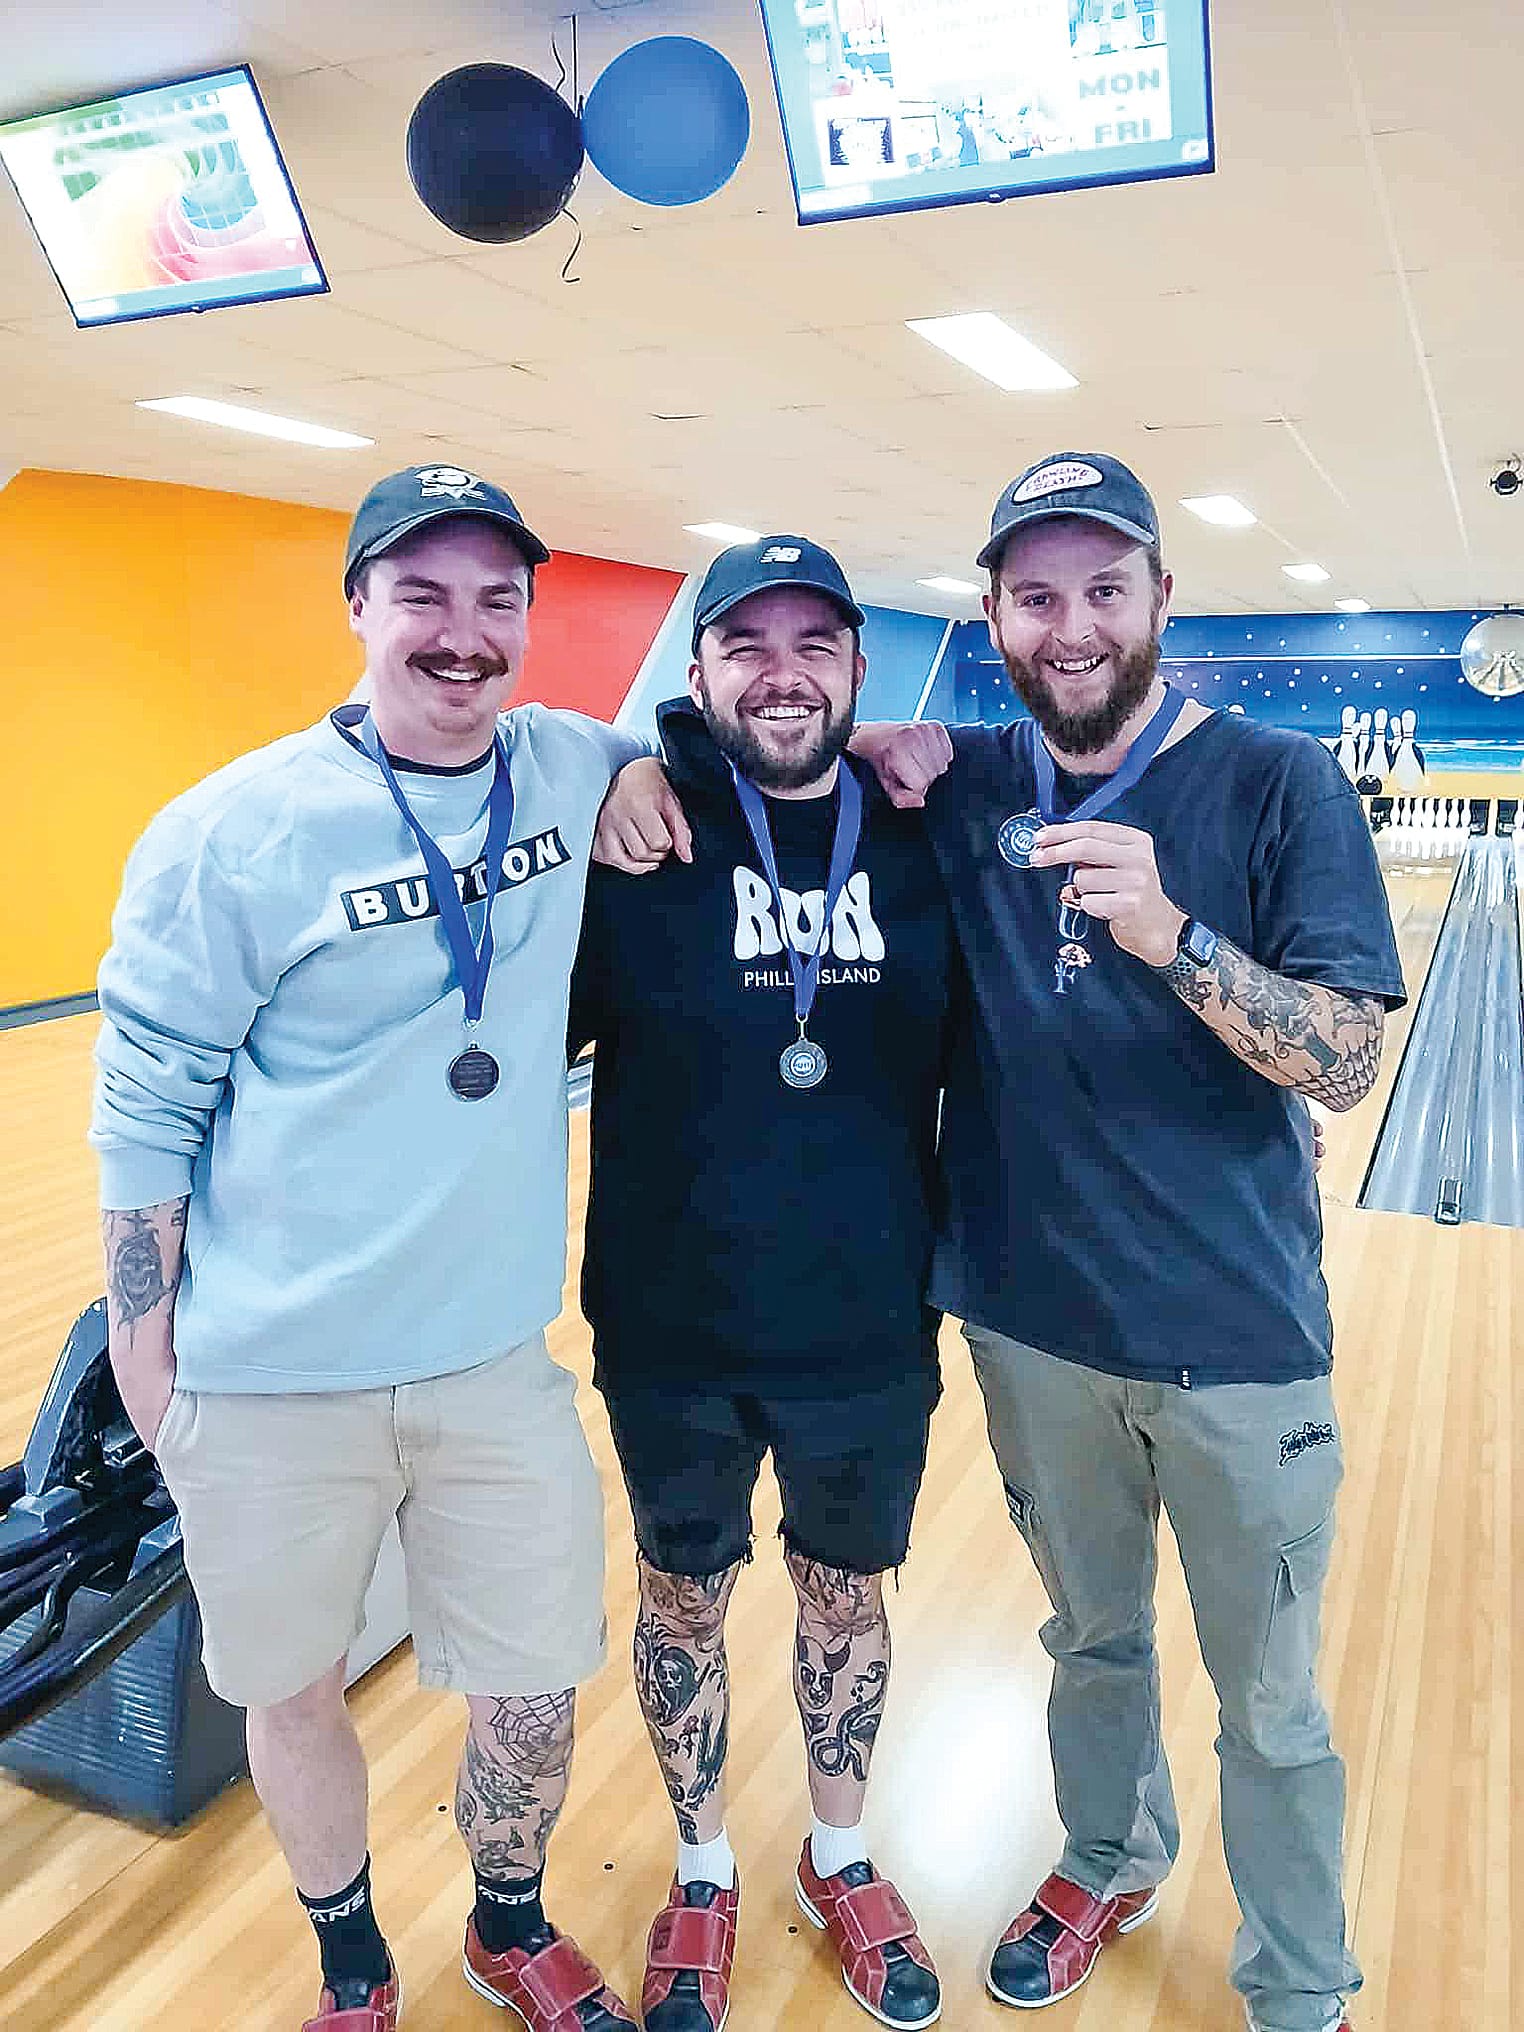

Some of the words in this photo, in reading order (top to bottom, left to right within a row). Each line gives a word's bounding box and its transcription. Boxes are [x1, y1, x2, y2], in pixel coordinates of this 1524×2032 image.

[1079, 68, 1160, 99] MON
[1094, 118, 1152, 144] FRI
[744, 970, 795, 988] PHILL
[816, 967, 882, 985] ISLAND
